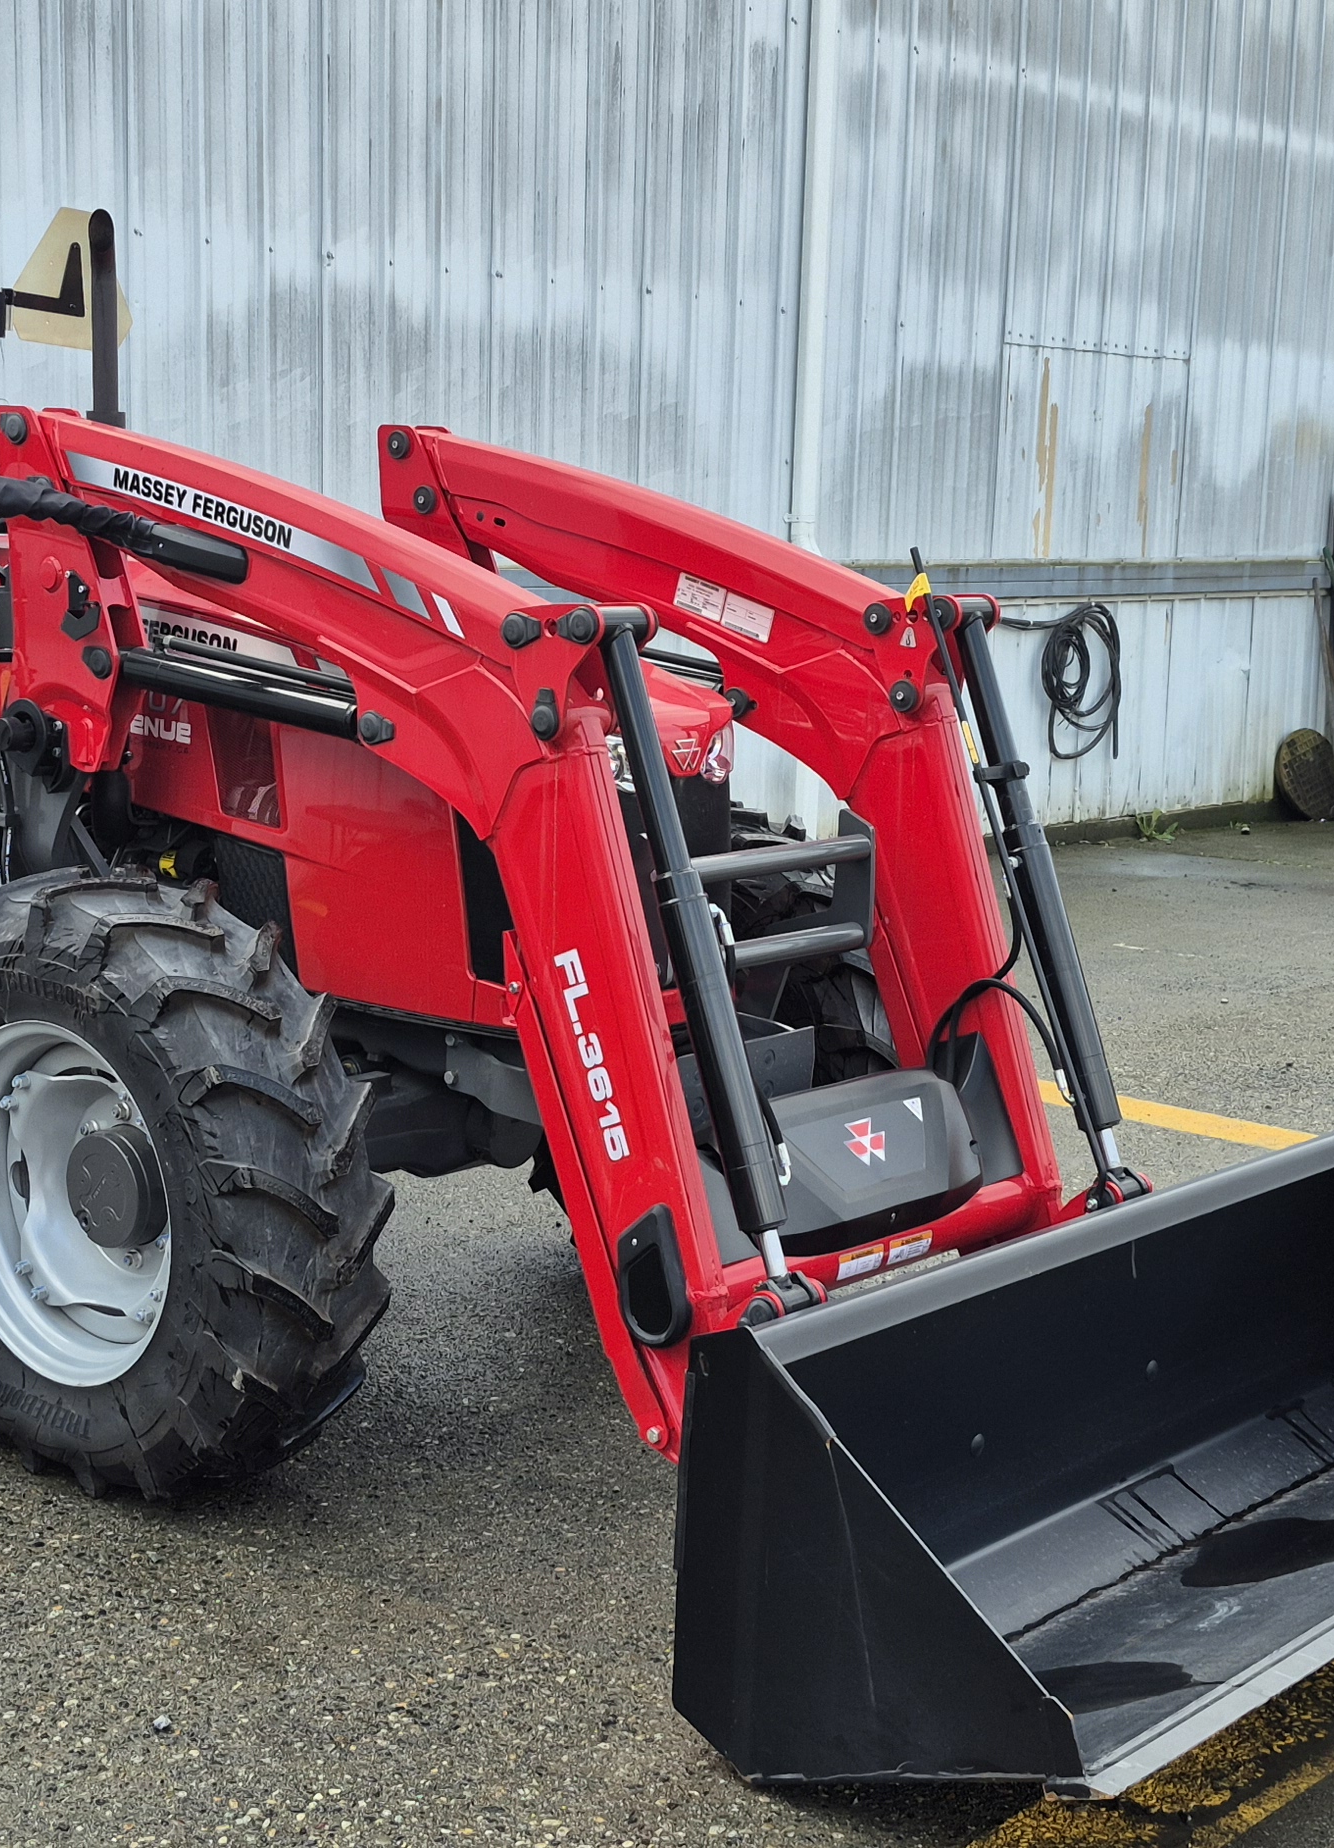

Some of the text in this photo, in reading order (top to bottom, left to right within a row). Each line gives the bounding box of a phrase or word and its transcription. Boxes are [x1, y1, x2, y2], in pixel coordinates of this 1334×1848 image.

[112, 467, 293, 550] MASSEY FERGUSON
[129, 713, 192, 745] ENUE
[553, 947, 631, 1163] FL.3615
